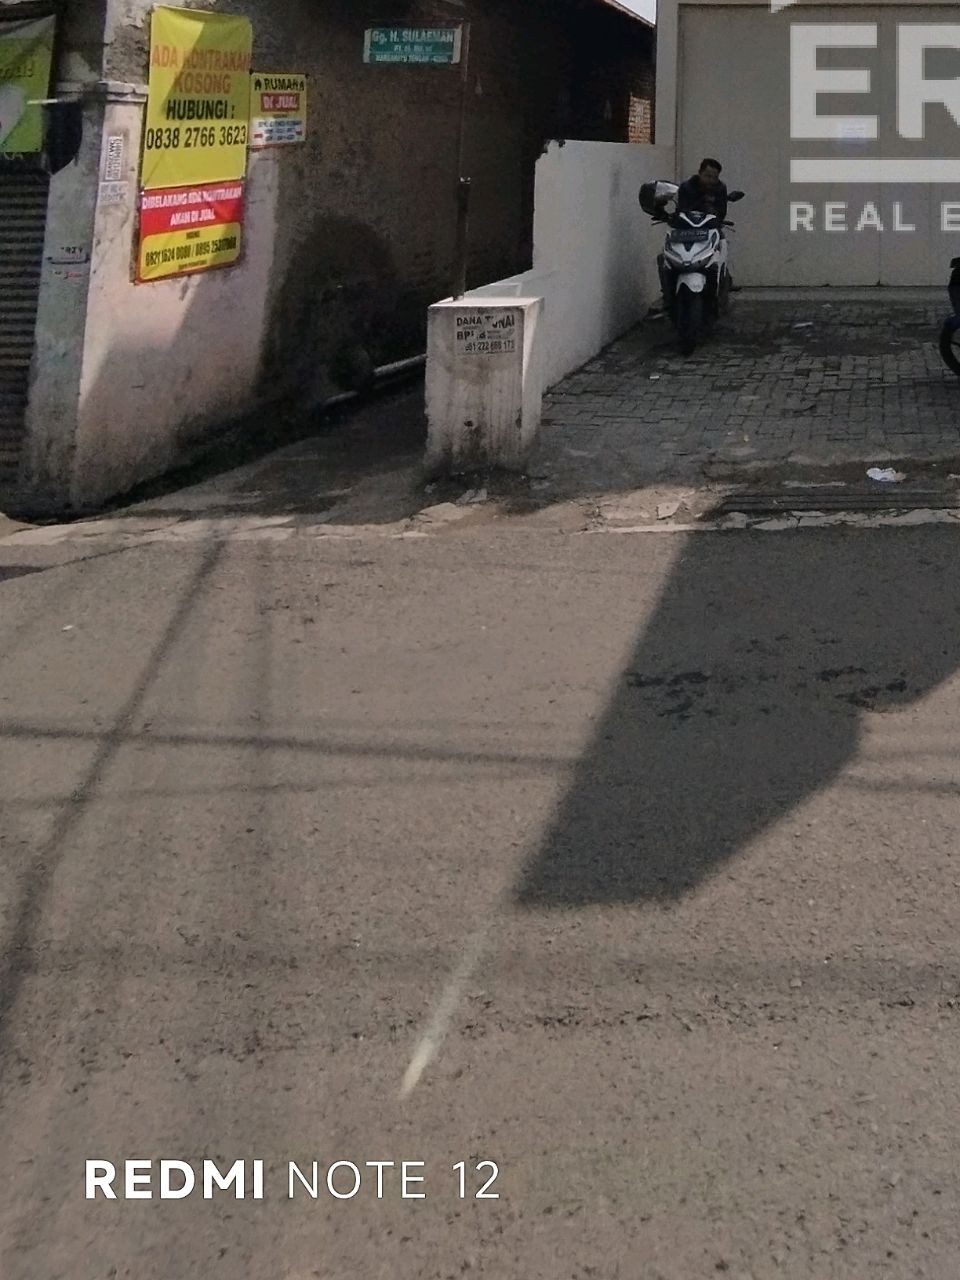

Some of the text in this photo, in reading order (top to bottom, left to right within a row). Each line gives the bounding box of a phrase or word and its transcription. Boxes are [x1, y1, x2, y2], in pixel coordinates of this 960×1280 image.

[152, 45, 178, 67] ADA
[175, 71, 231, 94] KOSONG
[265, 78, 298, 91] RUMAH
[166, 100, 228, 120] HUBUNGI
[146, 125, 247, 150] 0838 2766 3623
[457, 316, 482, 327] DANA
